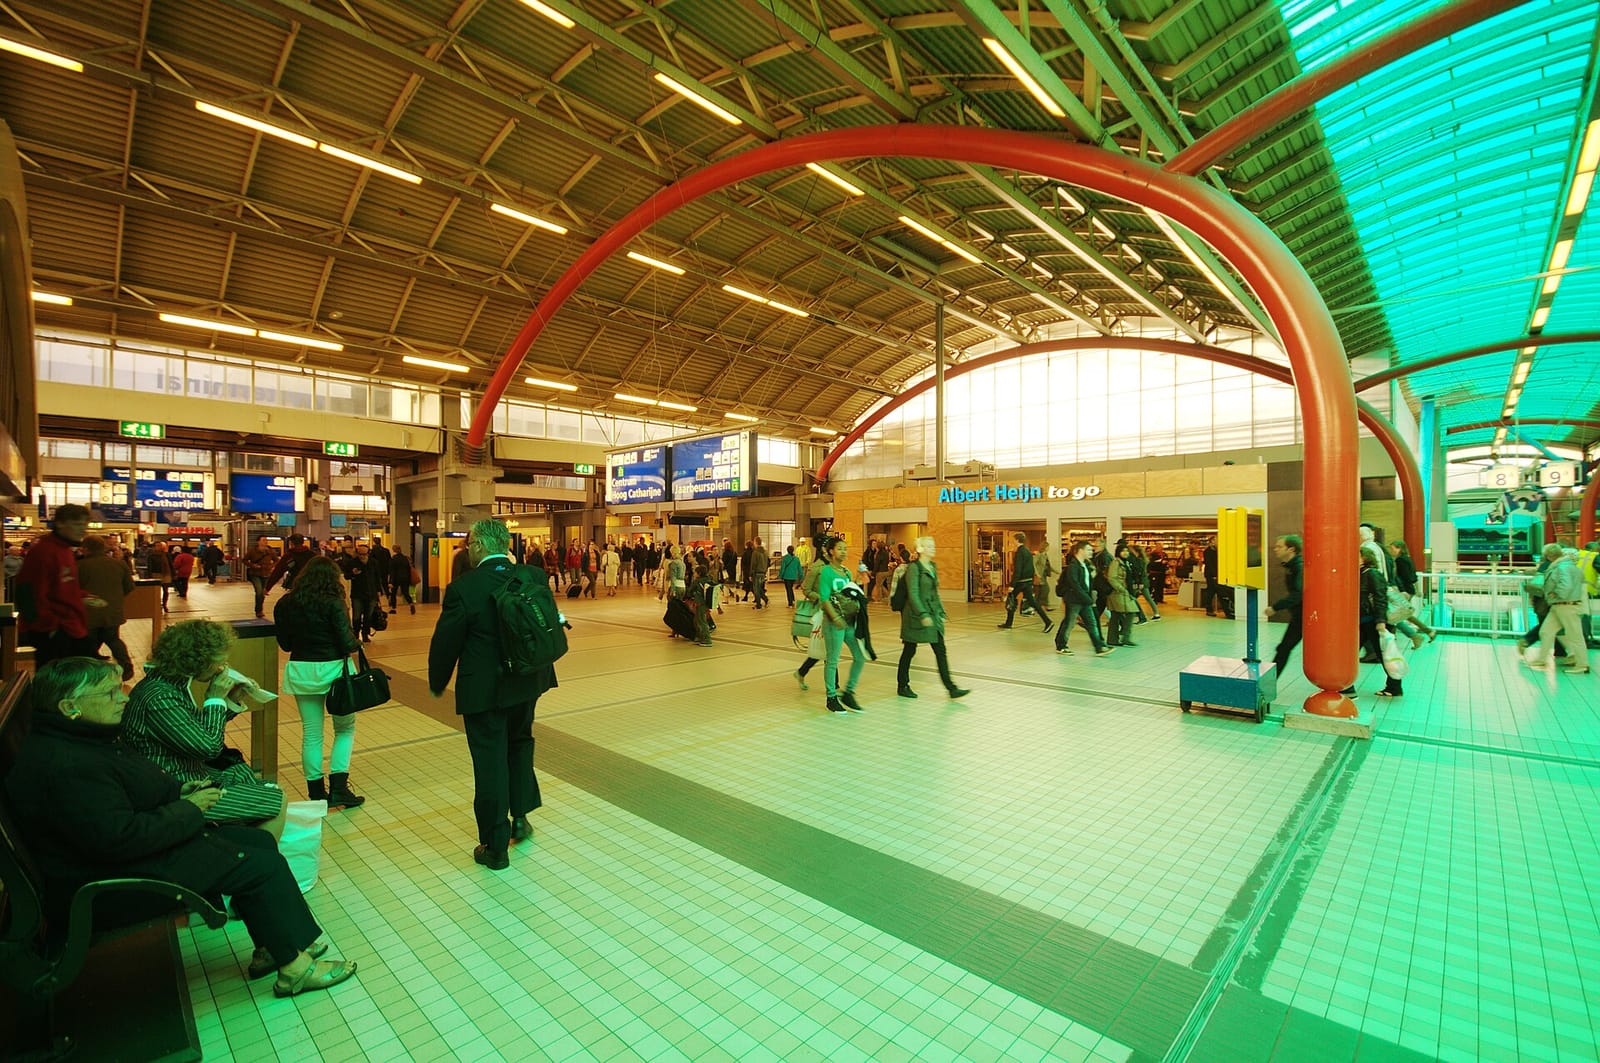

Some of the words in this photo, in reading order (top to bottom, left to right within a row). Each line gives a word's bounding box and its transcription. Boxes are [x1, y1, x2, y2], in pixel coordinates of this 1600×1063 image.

[612, 477, 638, 489] Centrum
[1495, 473, 1507, 486] 8
[1550, 471, 1561, 484] 9
[155, 489, 204, 498] Centrum
[628, 486, 662, 500] Catharijne
[674, 479, 731, 495] Jaarbeursplein
[938, 486, 989, 503] Albert
[995, 483, 1042, 503] Heijn
[1047, 485, 1069, 499] to
[1071, 485, 1101, 500] go
[145, 499, 204, 510] Catharijne
